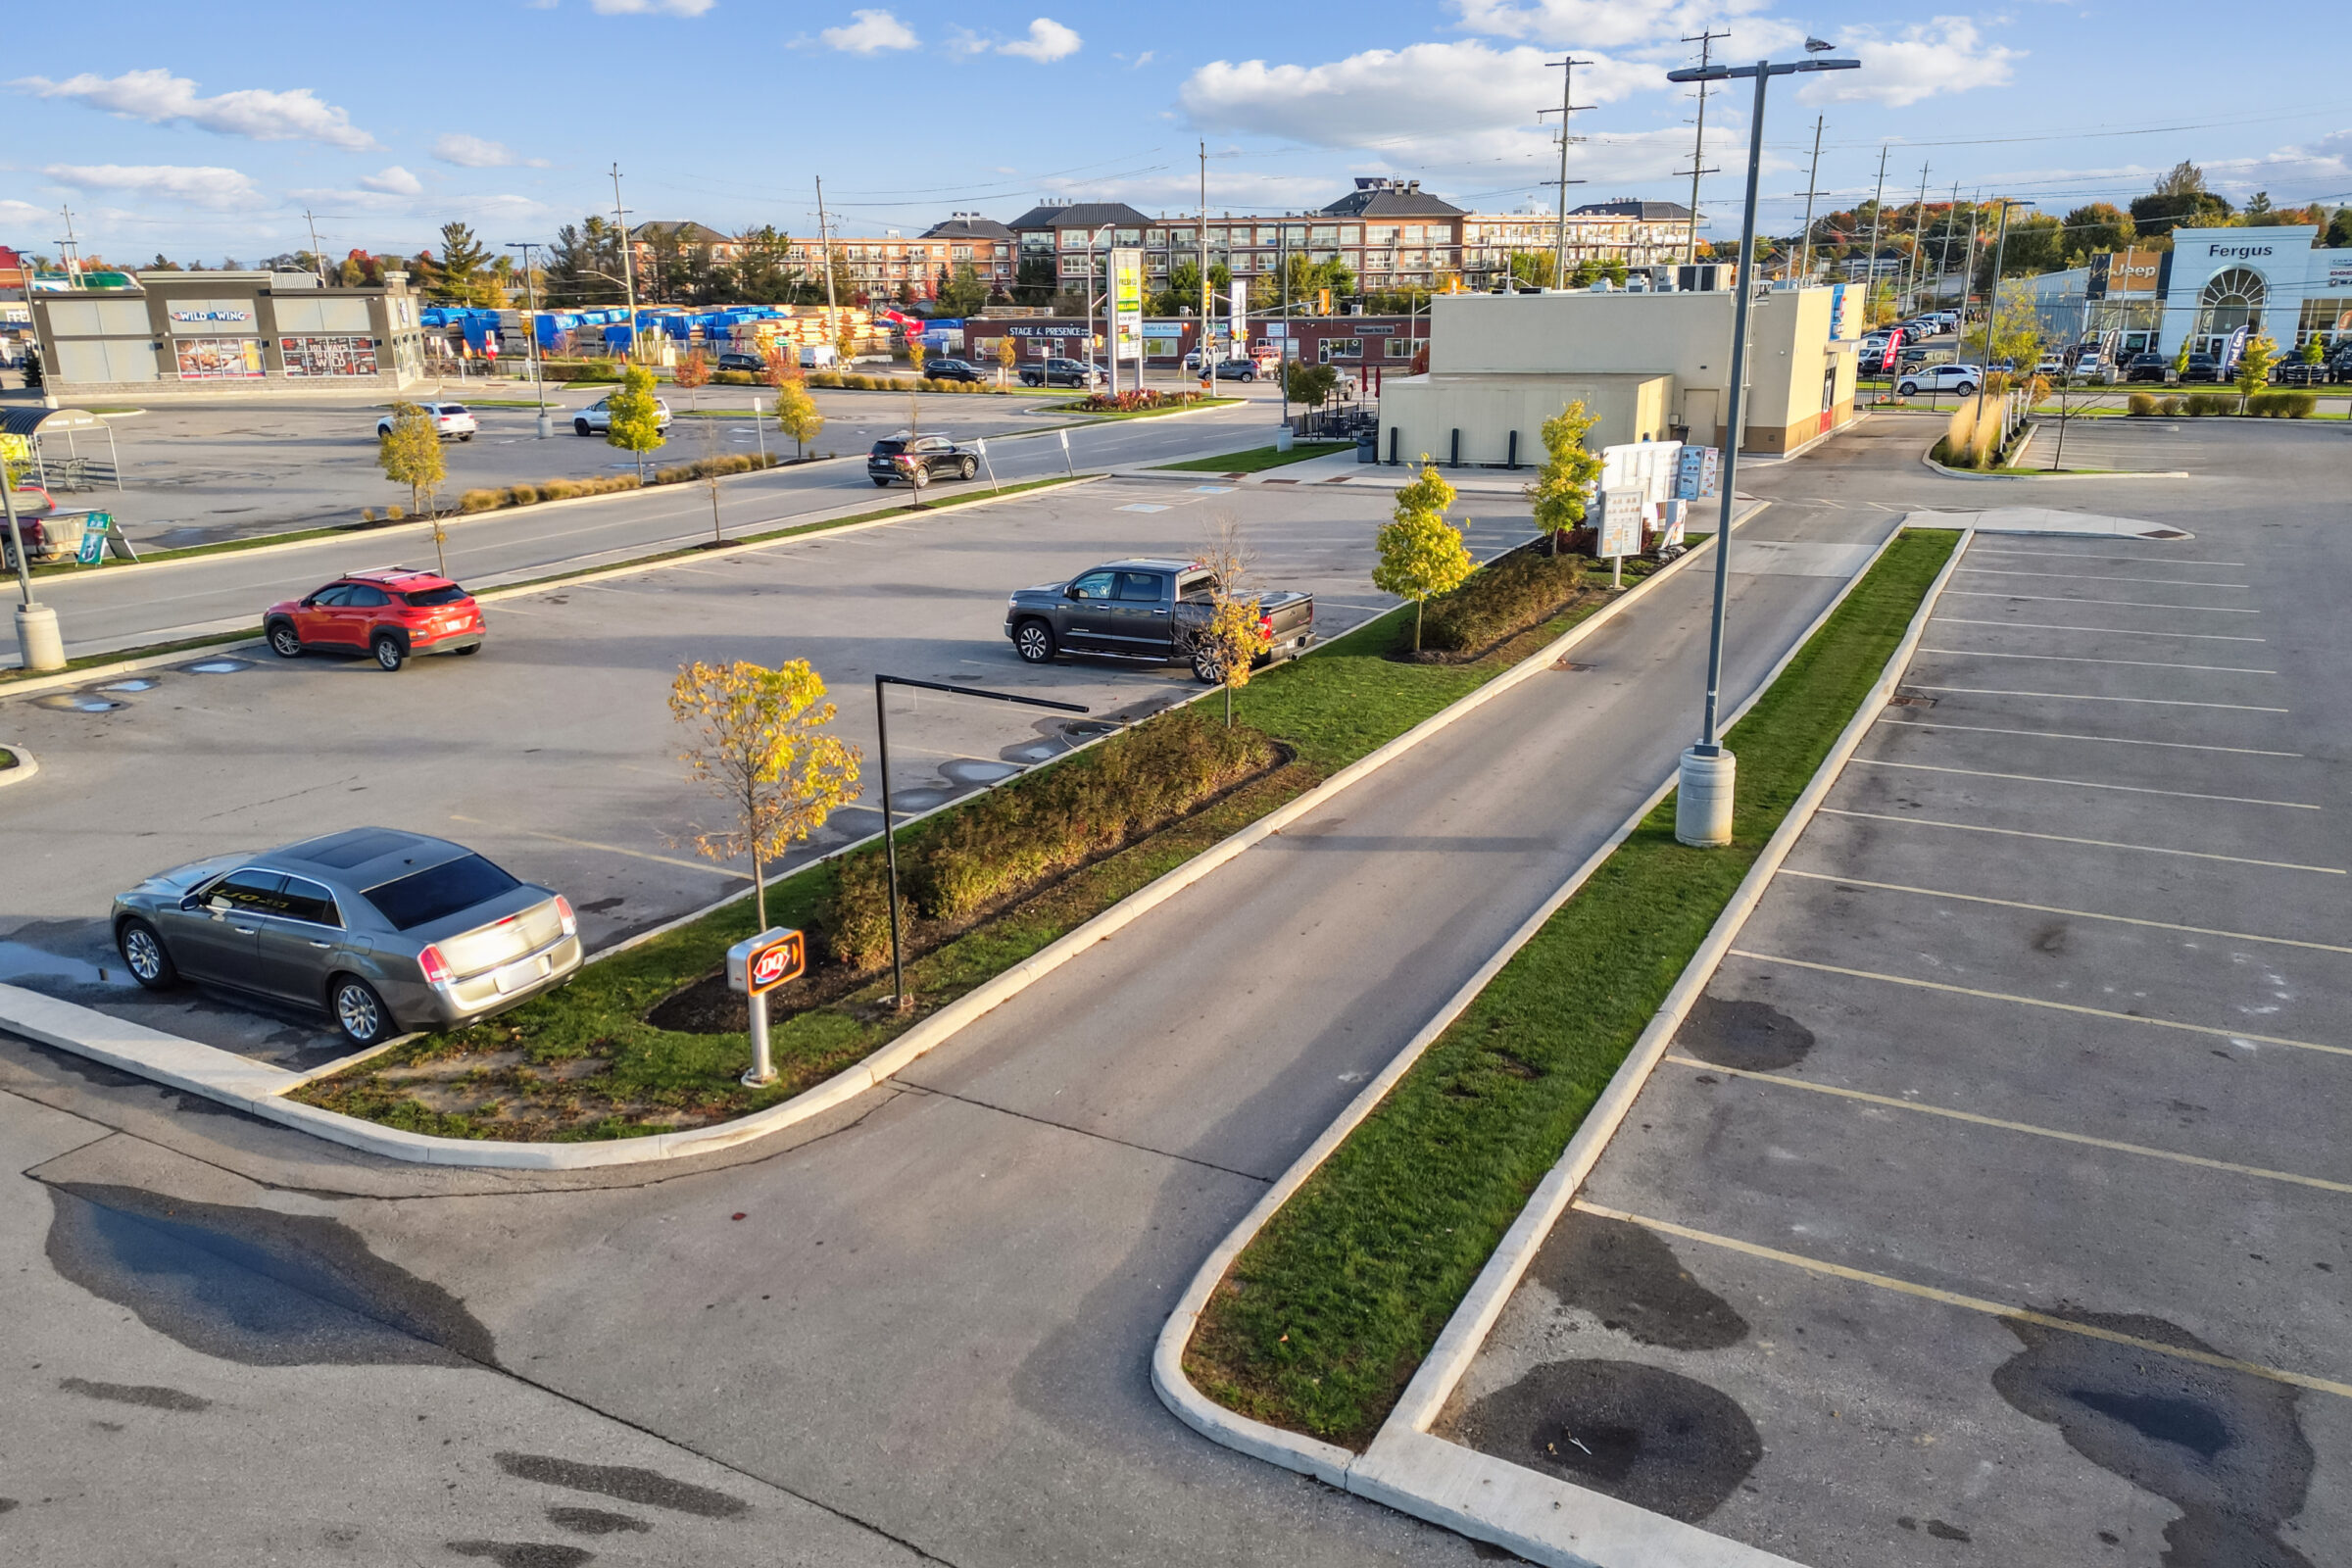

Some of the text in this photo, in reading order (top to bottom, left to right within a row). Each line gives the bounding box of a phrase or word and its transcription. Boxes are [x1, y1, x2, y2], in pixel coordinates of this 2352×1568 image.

[2209, 244, 2273, 259] Fergus
[2113, 264, 2156, 279] Jeep
[179, 311, 246, 321] WILD WING
[1009, 326, 1033, 335] STAGE
[1045, 326, 1081, 336] PRESENCE
[2232, 331, 2245, 347] Cars
[760, 952, 784, 976] DQ
